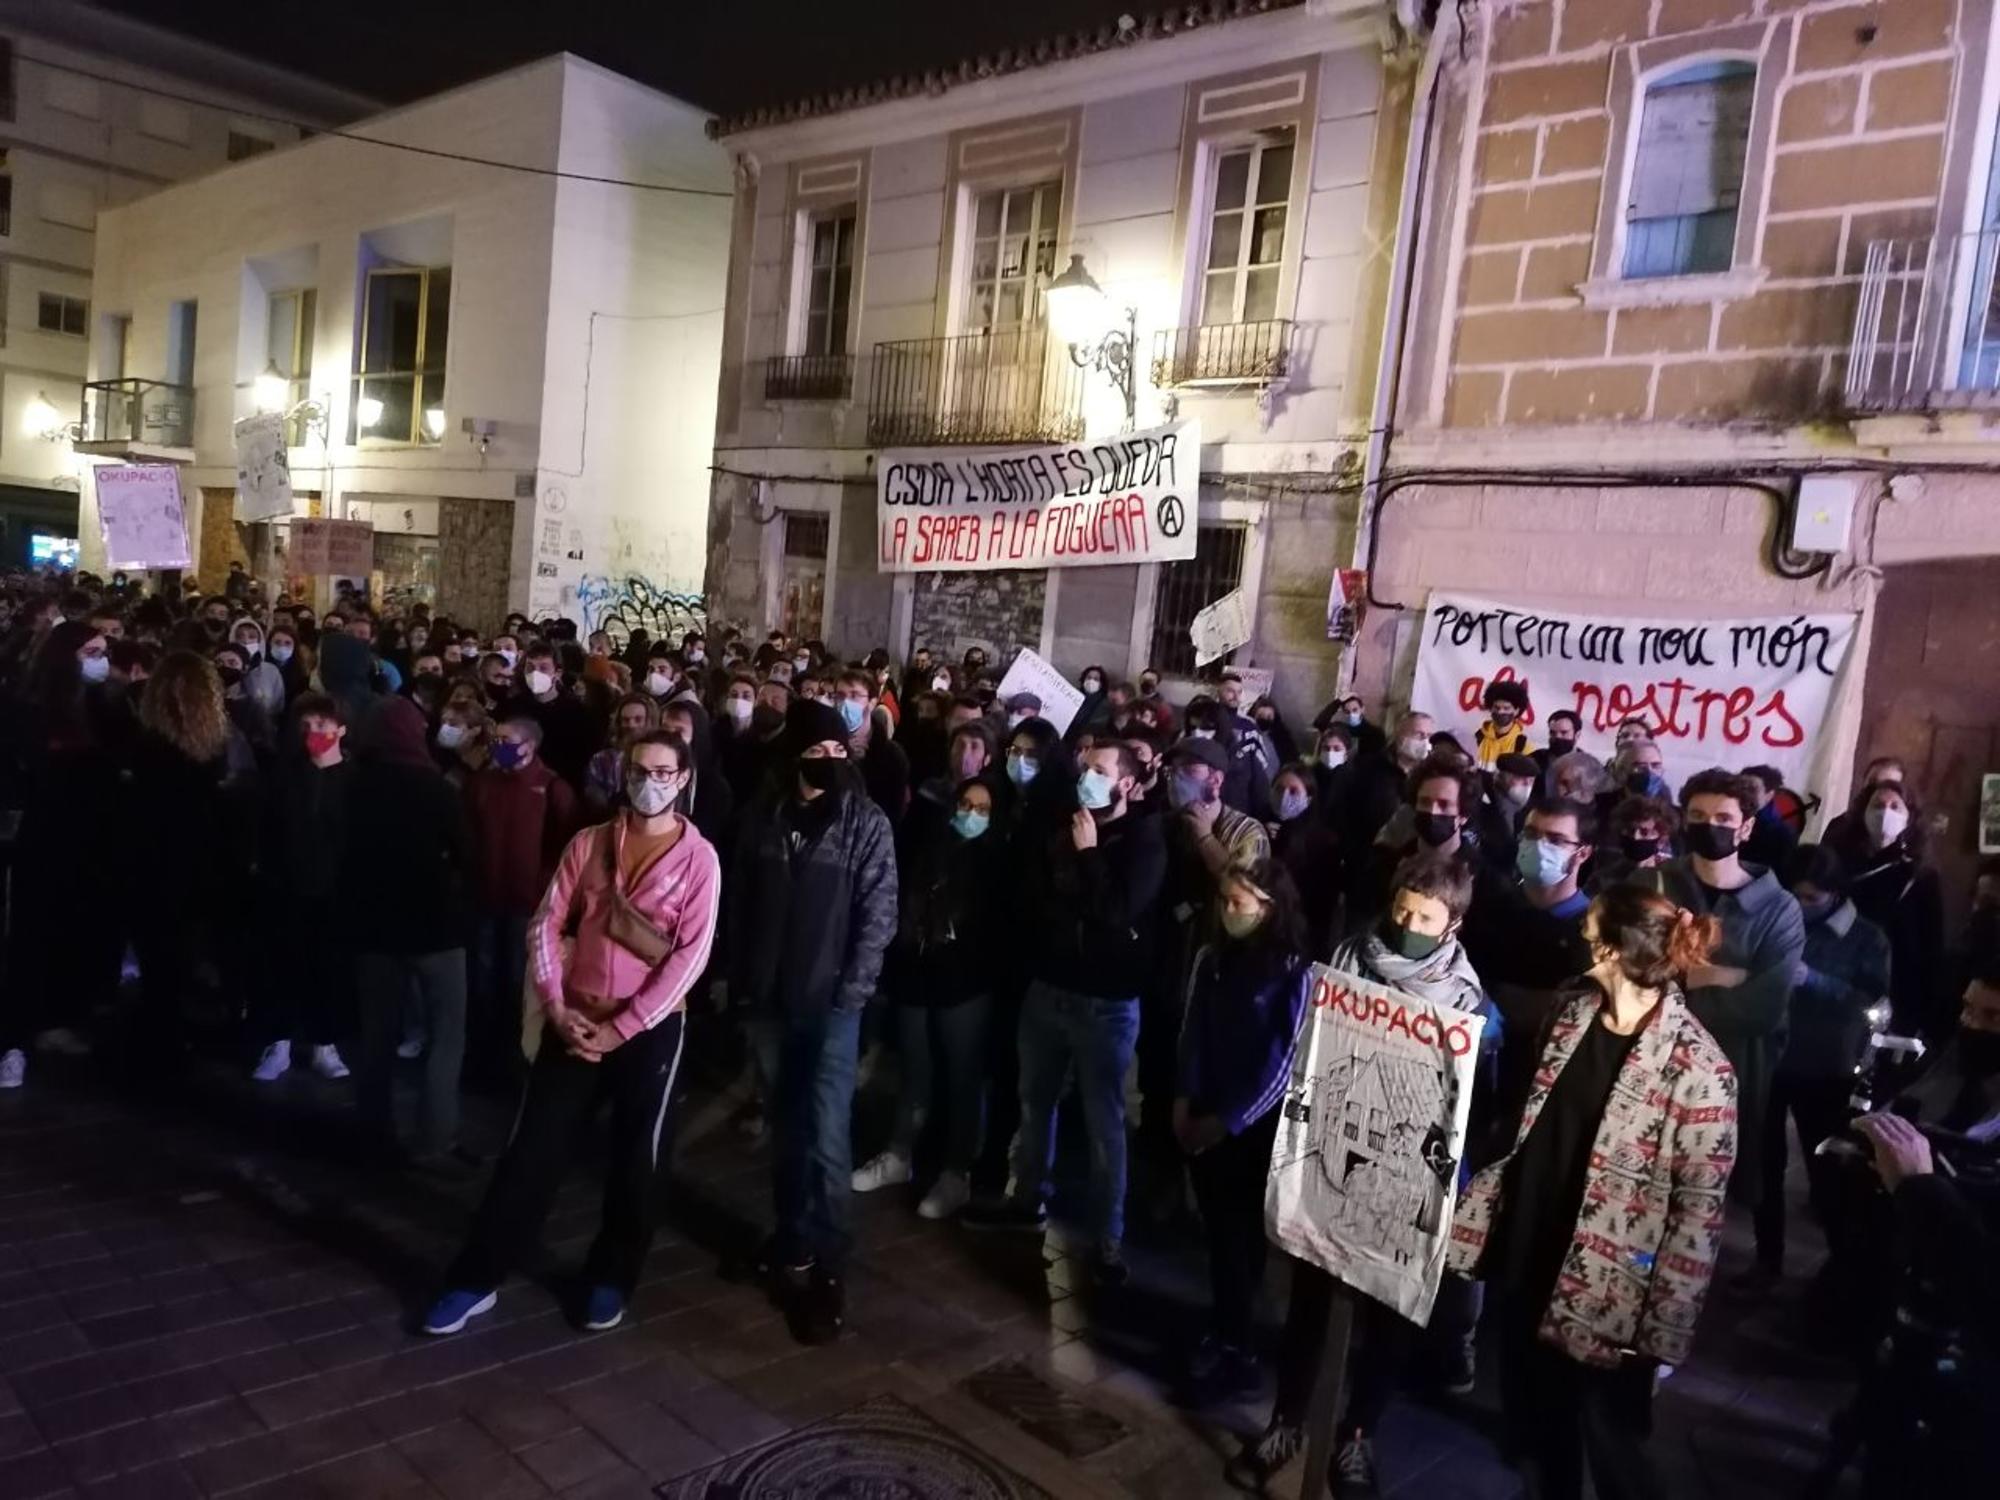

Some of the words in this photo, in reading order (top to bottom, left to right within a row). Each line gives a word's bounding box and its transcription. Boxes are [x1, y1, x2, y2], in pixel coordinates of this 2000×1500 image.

[1052, 449, 1095, 497] ES
[1093, 433, 1178, 495] QUEDA
[881, 518, 908, 562] LA
[913, 514, 981, 562] SAREB
[986, 512, 1008, 561] A
[1009, 509, 1040, 559] LA
[1042, 493, 1149, 558] FOGUERA
[1578, 623, 1625, 664] un
[1638, 624, 1714, 666] nou
[1731, 615, 1838, 676] món
[1572, 677, 1805, 748] nostres
[1311, 975, 1472, 1058] OKUPACIÓ
